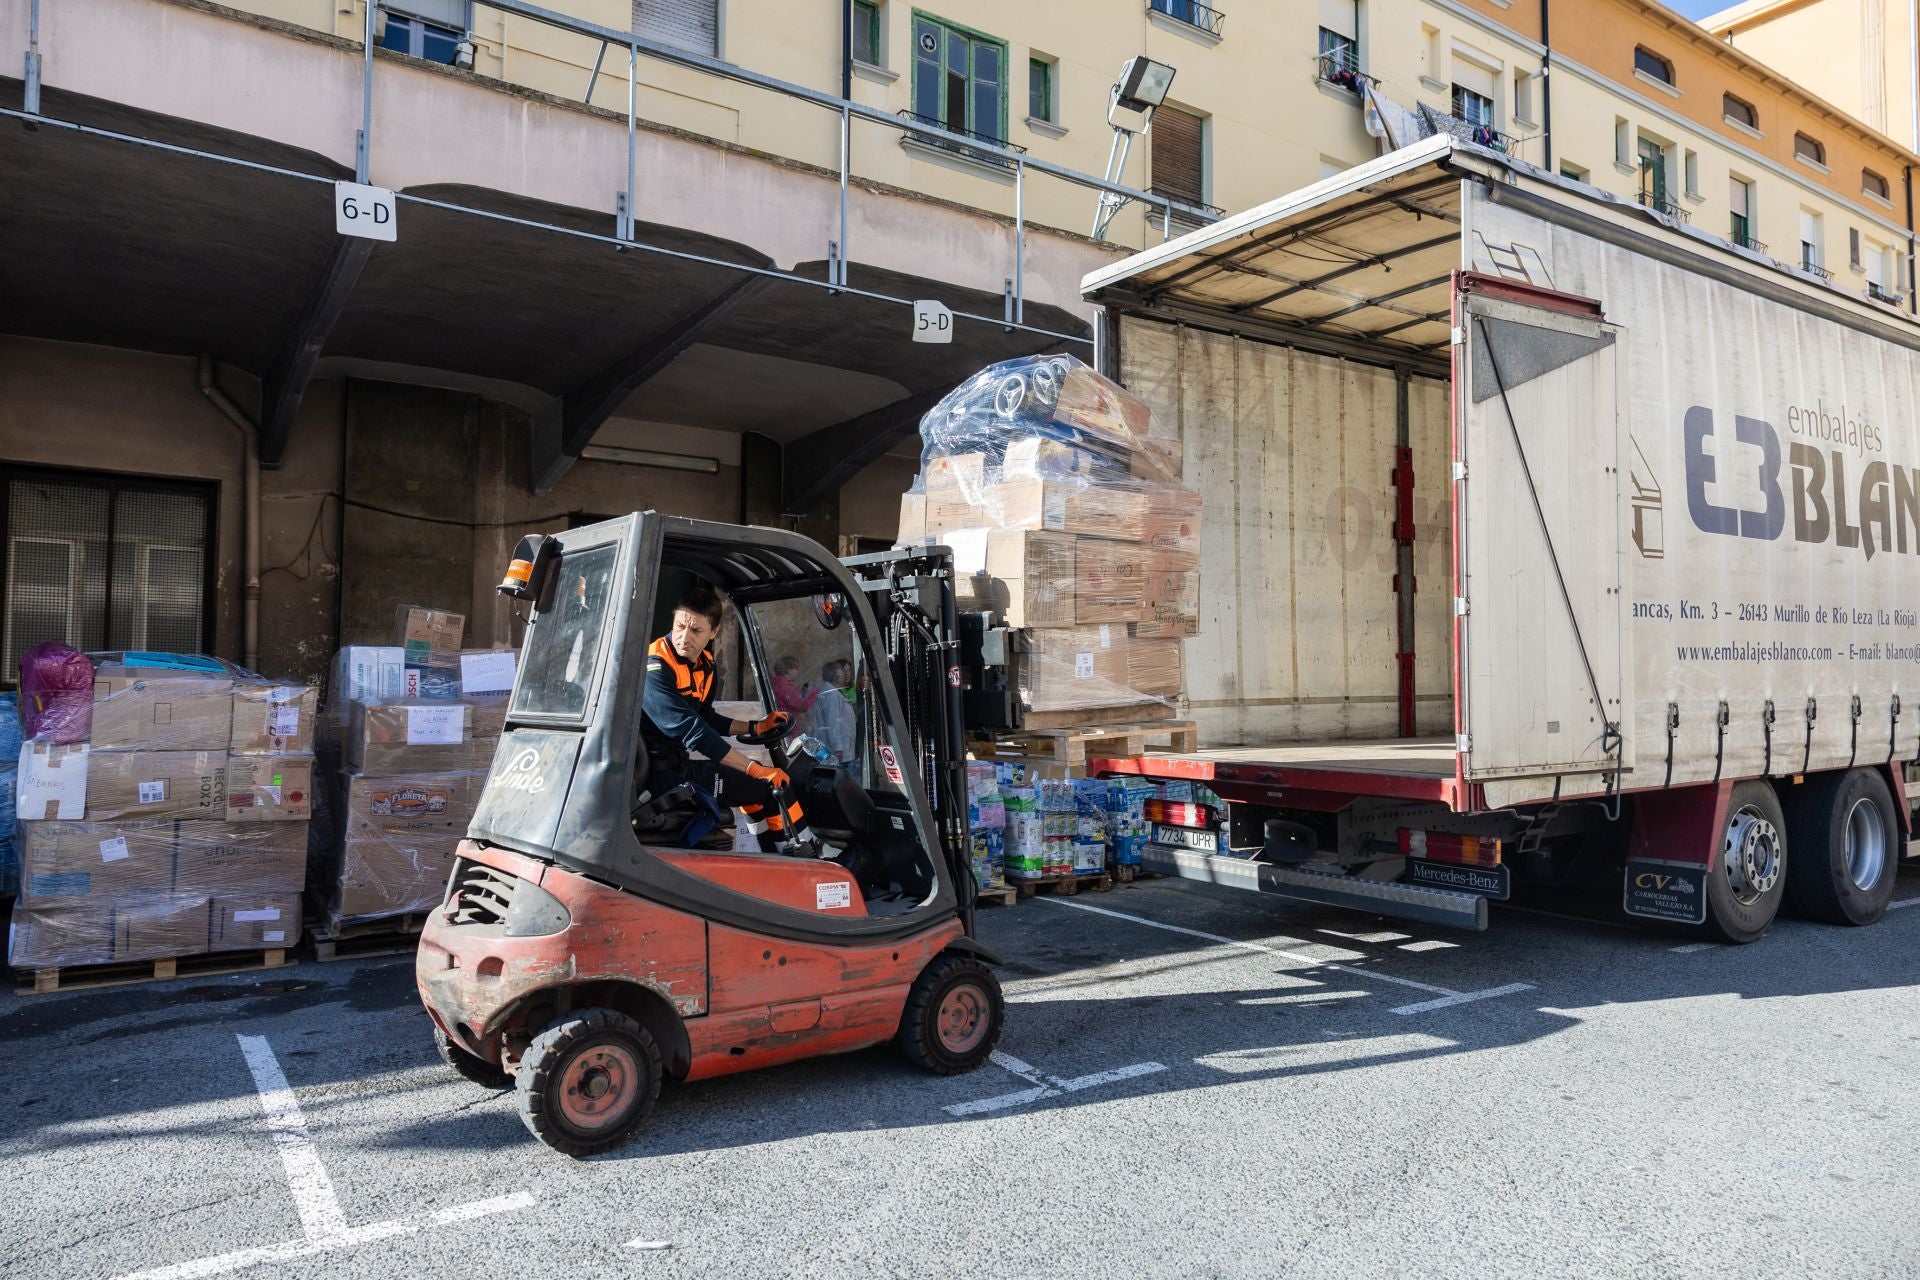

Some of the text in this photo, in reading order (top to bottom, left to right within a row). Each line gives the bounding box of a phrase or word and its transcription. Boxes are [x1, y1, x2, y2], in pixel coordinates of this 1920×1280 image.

[342, 197, 389, 224] 6-D
[918, 312, 949, 331] 5-D
[1788, 398, 1882, 457] embalajes
[1789, 441, 1920, 562] BLAN
[1680, 599, 1705, 619] Km.
[1711, 601, 1718, 619] 3
[1738, 603, 1768, 621] 26143
[1773, 604, 1810, 622] Murillo
[1815, 604, 1828, 623] de
[1852, 607, 1873, 625] Leza
[1877, 608, 1890, 626] (La
[1894, 609, 1917, 629] Rioja)
[1677, 640, 1832, 664] www.embalajesblanco.com
[1849, 642, 1881, 661] E-mail:
[200, 776, 212, 798] BOX
[1161, 827, 1211, 848] 7734 DPR
[1413, 864, 1499, 889] Mercedes-Benz
[1635, 873, 1672, 890] CV
[1654, 899, 1682, 909] VALLEJO
[1683, 903, 1695, 911] S.A.
